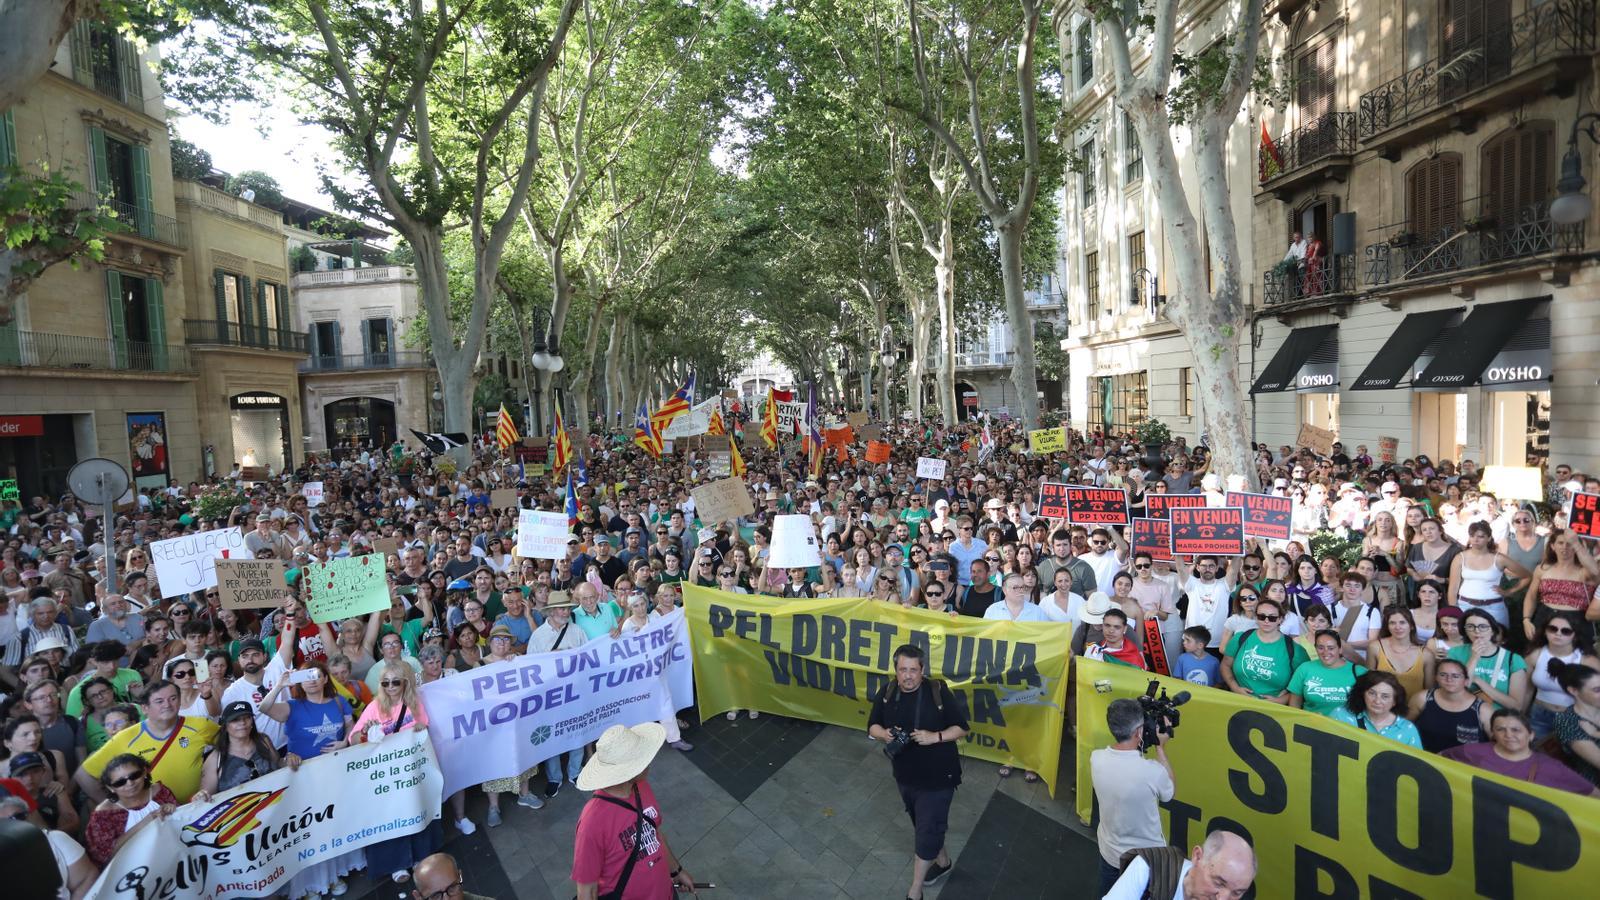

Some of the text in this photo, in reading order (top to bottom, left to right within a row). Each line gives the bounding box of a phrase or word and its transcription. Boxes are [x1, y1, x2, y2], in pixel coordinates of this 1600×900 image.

[1301, 374, 1335, 386] OYSHO
[1431, 375, 1465, 383] OYSHO
[1487, 366, 1542, 381] OYSHO
[1043, 485, 1057, 497] EN
[1068, 490, 1084, 501] EN
[1085, 490, 1125, 502] VENDA
[1149, 497, 1207, 509] EN VENDA
[1227, 494, 1291, 513] EN VENDA
[1135, 521, 1150, 533] EN
[1173, 510, 1242, 525] EN VENDA
[153, 528, 242, 562] REGULACIÓ
[225, 578, 272, 589] PER PODER
[708, 604, 781, 651] PEL
[790, 613, 898, 672] DRET
[942, 633, 1042, 687] UNA
[1148, 626, 1159, 648] VOX
[471, 622, 675, 701] PER UN ALTRE
[1155, 656, 1165, 669] PP
[763, 650, 859, 701] VIDA
[453, 682, 581, 740] MODEL
[588, 640, 686, 694] TURÍSTIC
[554, 729, 565, 737] DE
[589, 716, 598, 725] DE
[599, 707, 621, 721] PALMA
[555, 709, 595, 730] FEDERACIÓ
[370, 770, 385, 781] de
[389, 766, 400, 776] la
[374, 784, 390, 796] de
[1226, 710, 1581, 900] STOP
[246, 804, 335, 862] Unión
[232, 831, 312, 876] BALEARES
[297, 848, 316, 862] No
[319, 843, 328, 853] a
[331, 837, 343, 849] la
[215, 864, 286, 897] Anticipada
